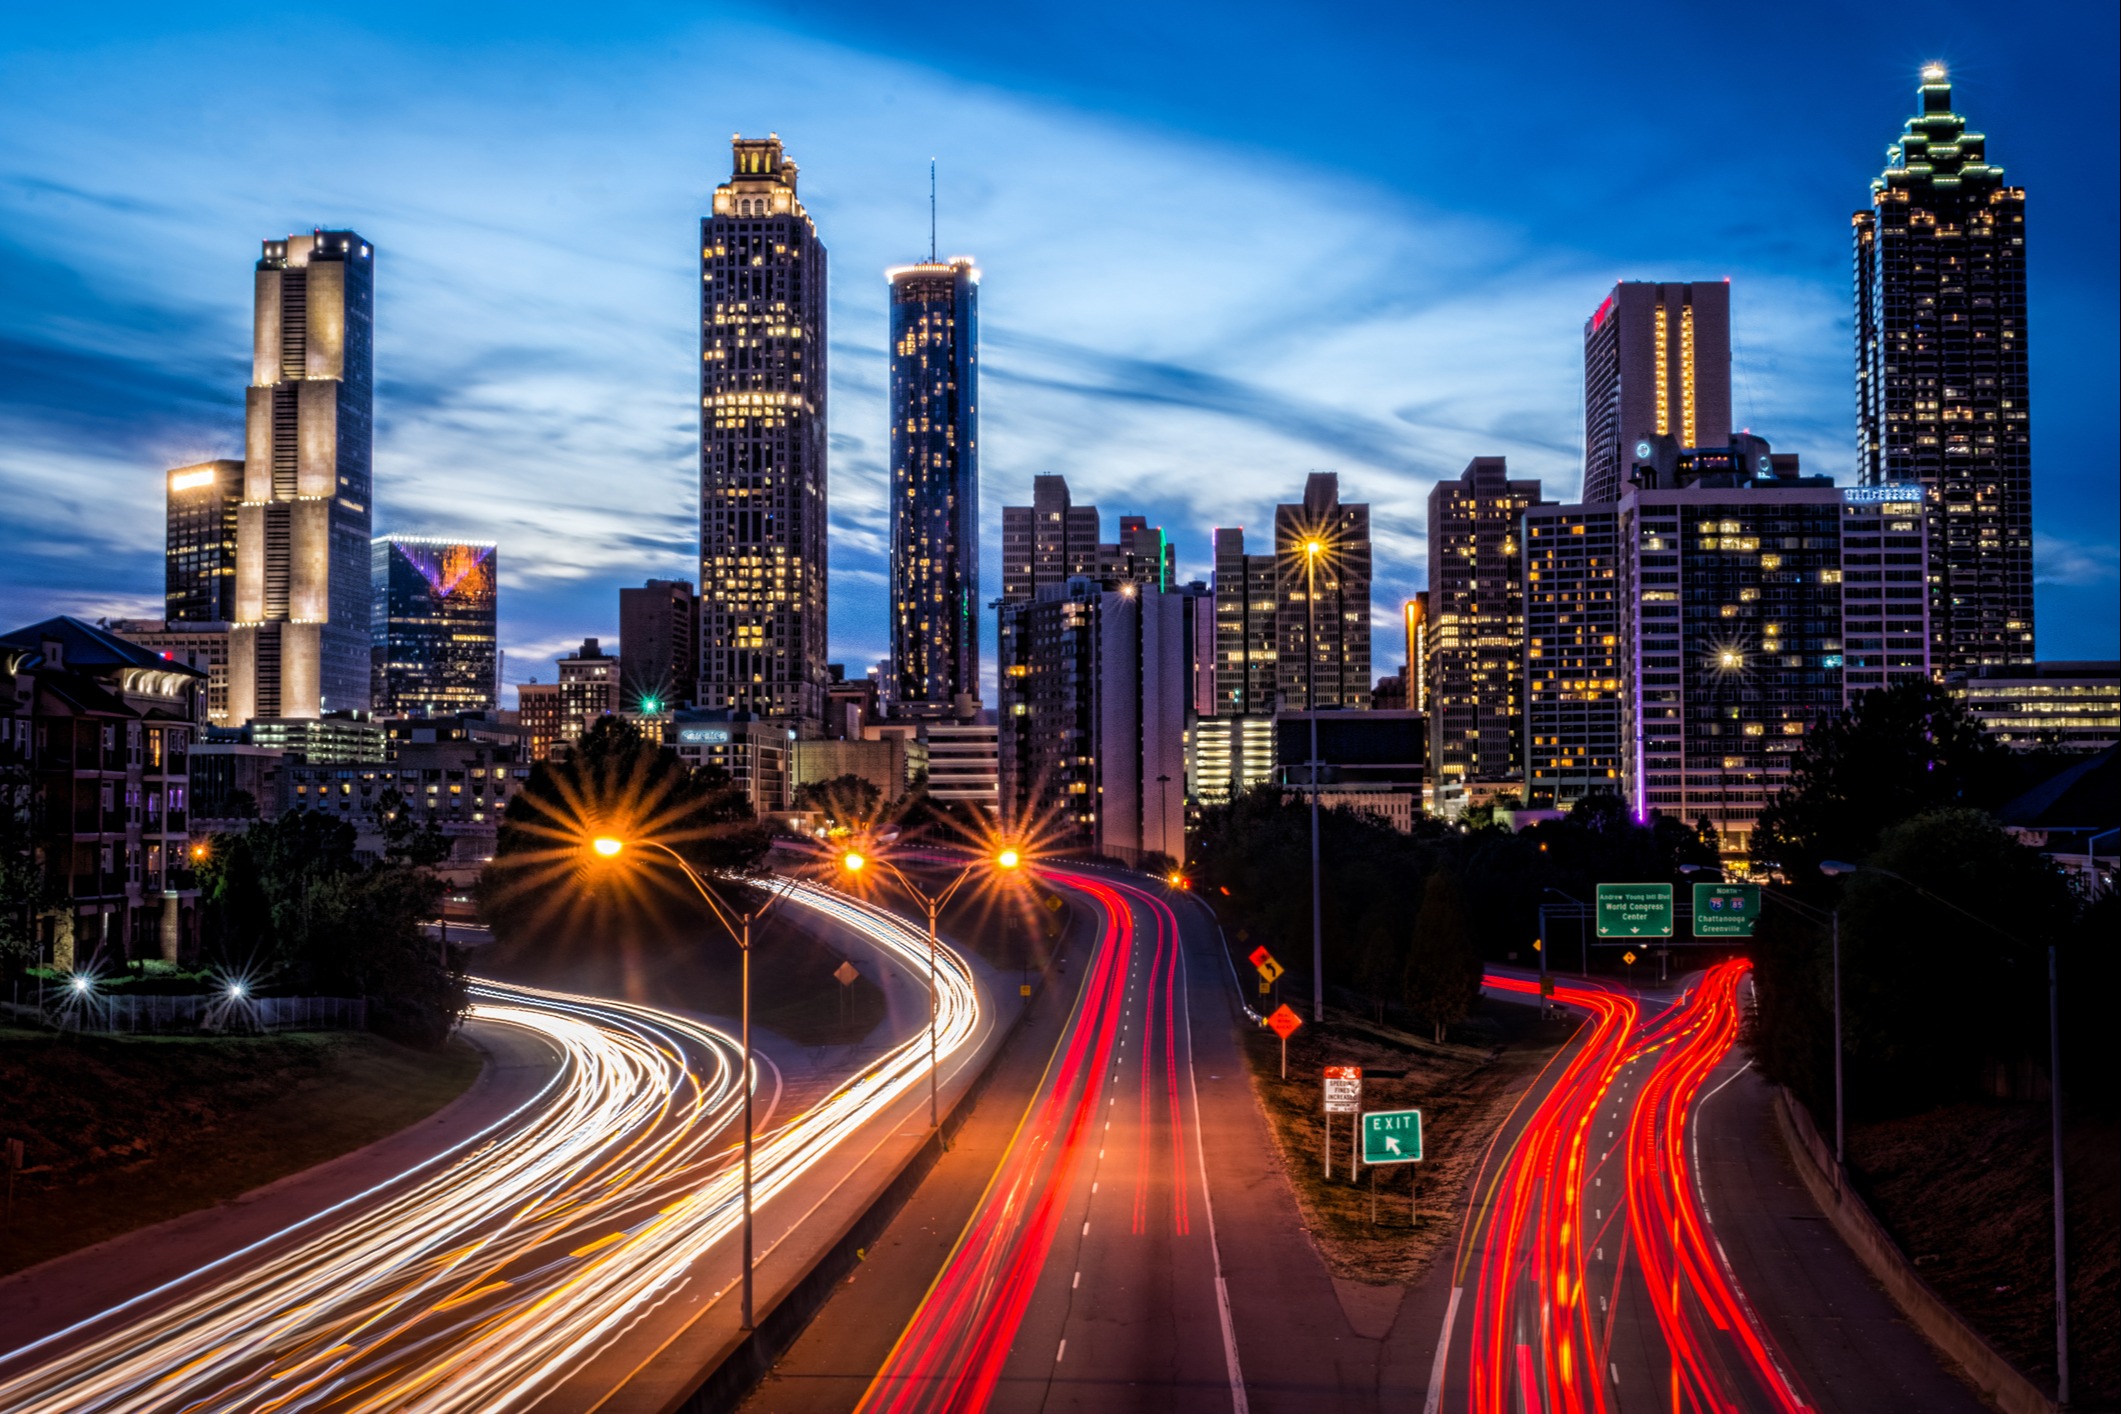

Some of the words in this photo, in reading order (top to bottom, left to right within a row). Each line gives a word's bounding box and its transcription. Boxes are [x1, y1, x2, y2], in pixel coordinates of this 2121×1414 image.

[1629, 903, 1664, 912] Congress
[1732, 901, 1743, 909] 85
[1698, 915, 1745, 924] Chattanooga
[1373, 1116, 1411, 1130] EXIT
